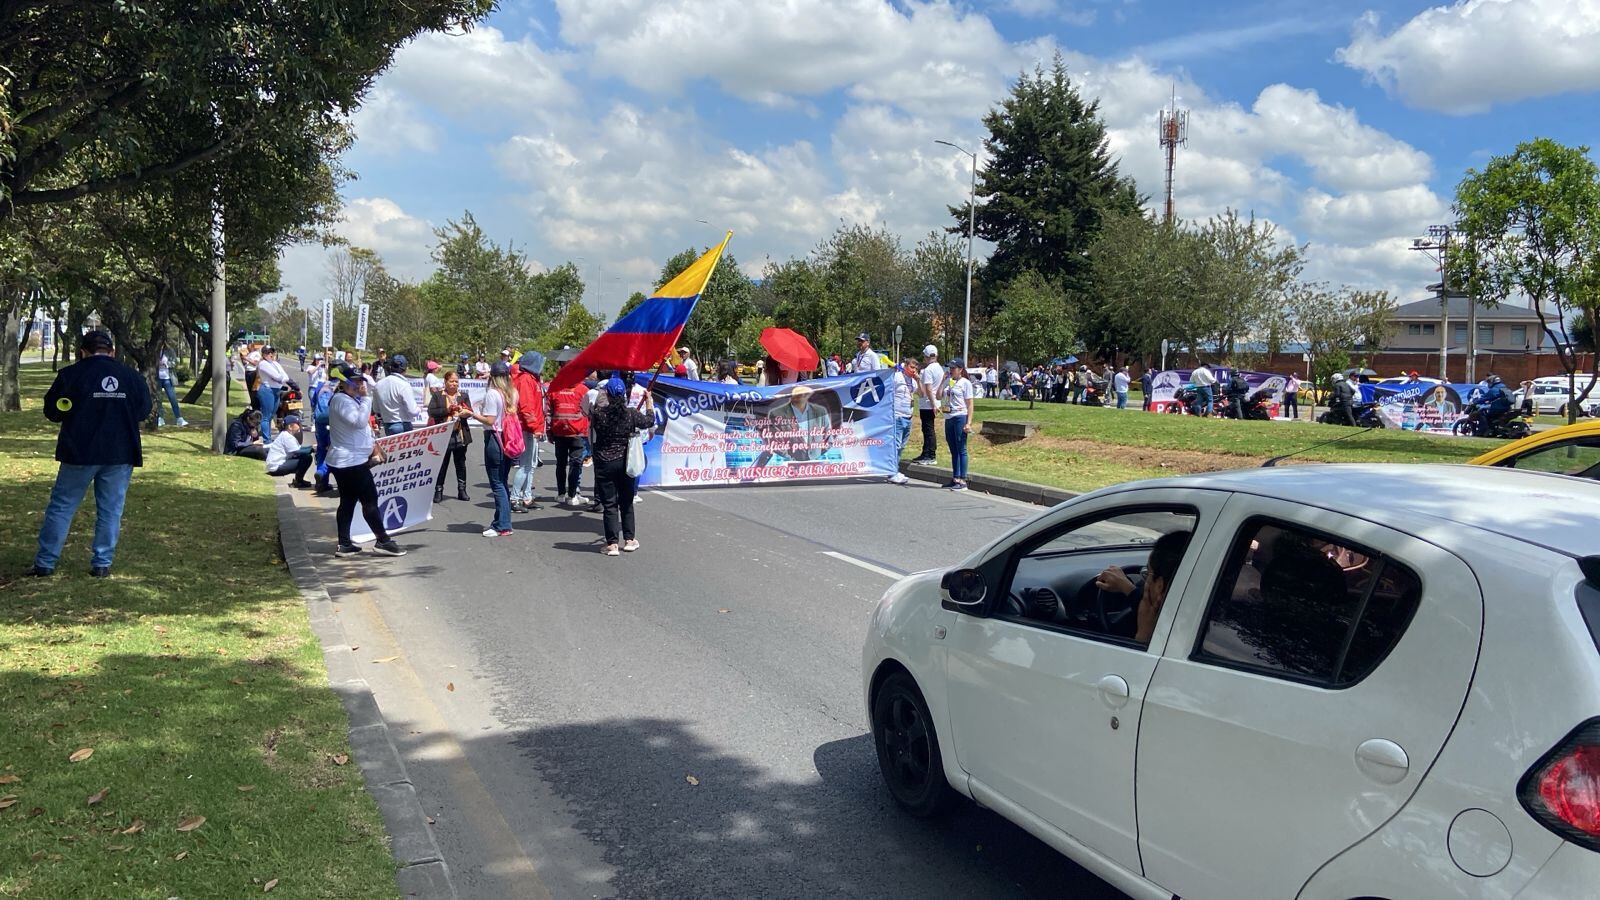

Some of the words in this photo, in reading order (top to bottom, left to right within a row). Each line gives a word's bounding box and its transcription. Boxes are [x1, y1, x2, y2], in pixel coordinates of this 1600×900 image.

[855, 377, 880, 404] A
[744, 431, 760, 439] con
[761, 429, 774, 439] la
[774, 428, 809, 438] comida
[809, 427, 825, 436] del
[398, 438, 427, 450] DIJO
[792, 442, 808, 453] por
[810, 440, 830, 449] más
[375, 468, 431, 488] ABILIDAD
[379, 469, 395, 479] NO
[397, 466, 405, 475] A
[407, 462, 421, 472] LA
[701, 468, 712, 480] A
[713, 468, 731, 480] LA
[734, 465, 795, 480] MASACRE
[378, 486, 400, 497] RAL
[402, 481, 417, 491] EN
[419, 477, 433, 487] LA
